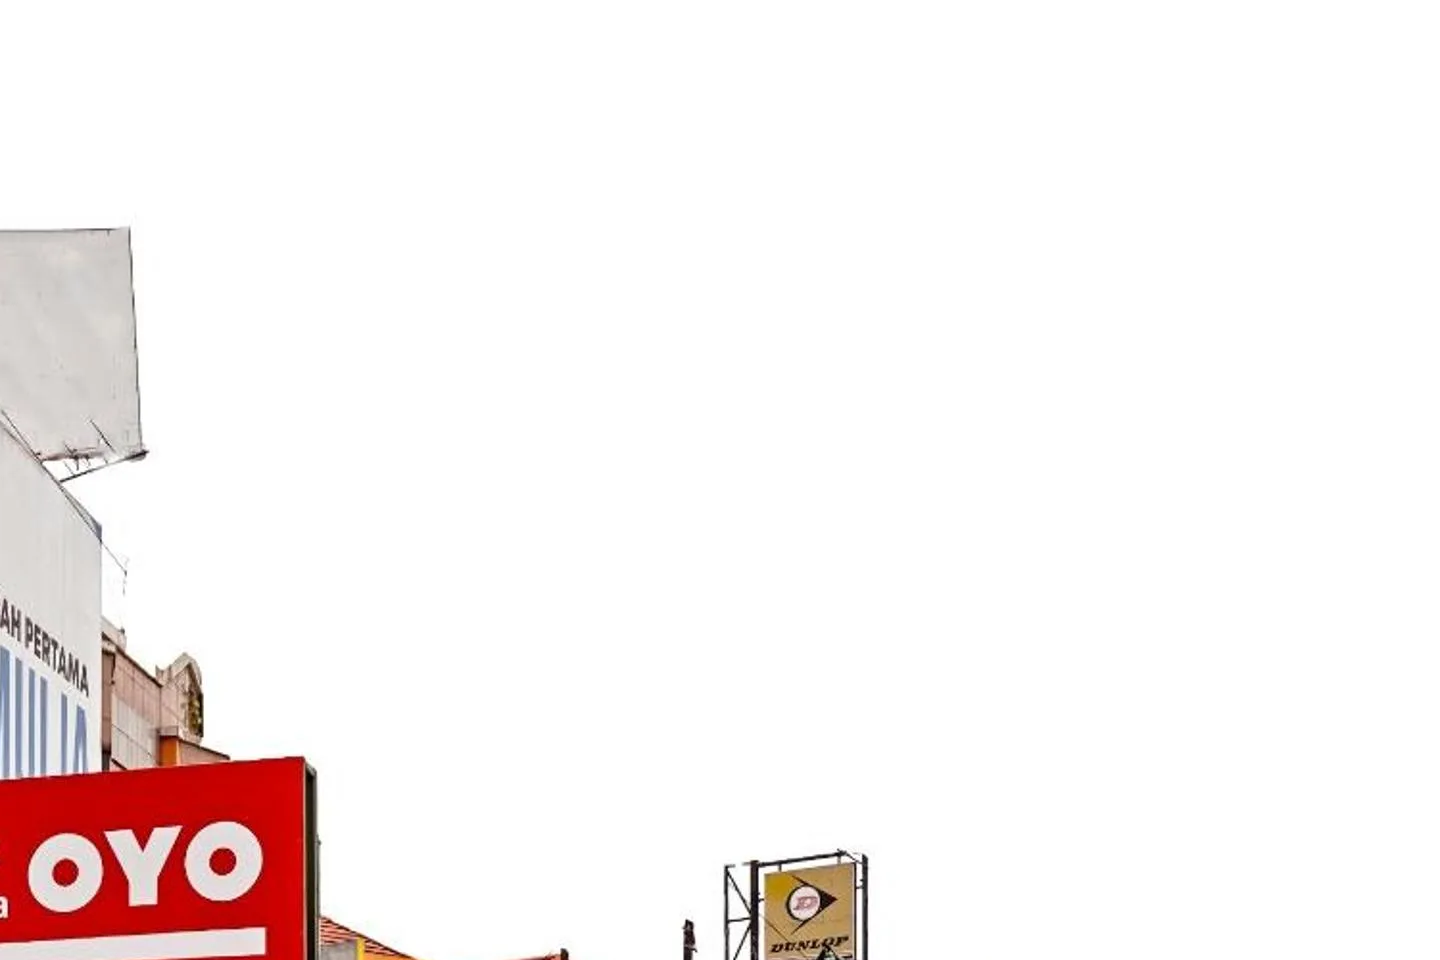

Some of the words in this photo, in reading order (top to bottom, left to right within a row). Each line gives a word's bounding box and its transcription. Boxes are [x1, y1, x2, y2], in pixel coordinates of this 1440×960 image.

[23, 616, 90, 697] PERTAMA
[27, 820, 264, 914] OYO
[771, 936, 850, 953] DUNLOP
